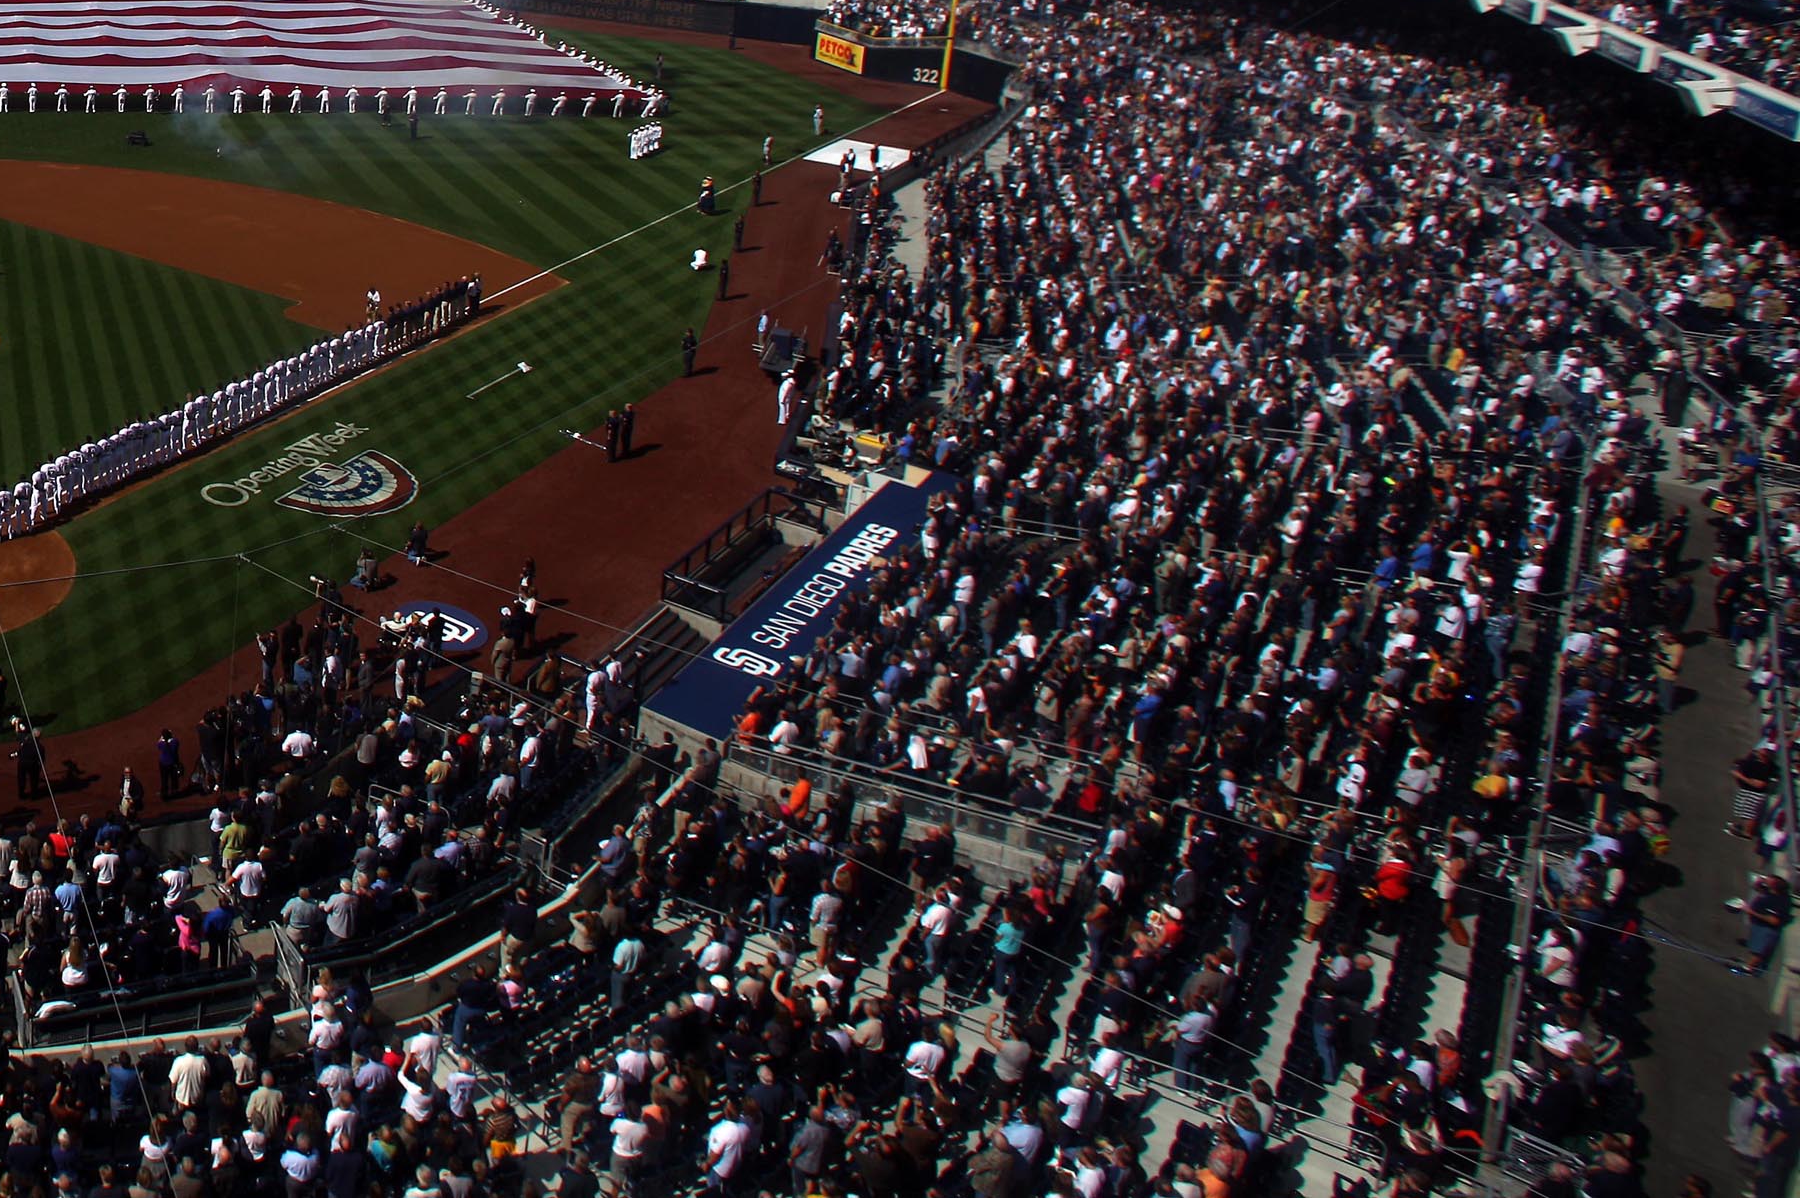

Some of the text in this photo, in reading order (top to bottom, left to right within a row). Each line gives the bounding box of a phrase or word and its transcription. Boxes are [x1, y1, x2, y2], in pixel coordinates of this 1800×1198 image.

[819, 38, 852, 60] PETCO
[912, 67, 939, 84] 322
[200, 421, 370, 506] Opening Week
[751, 612, 807, 650] SAN
[784, 573, 846, 618] DIEGO
[824, 523, 899, 578] PADRES
